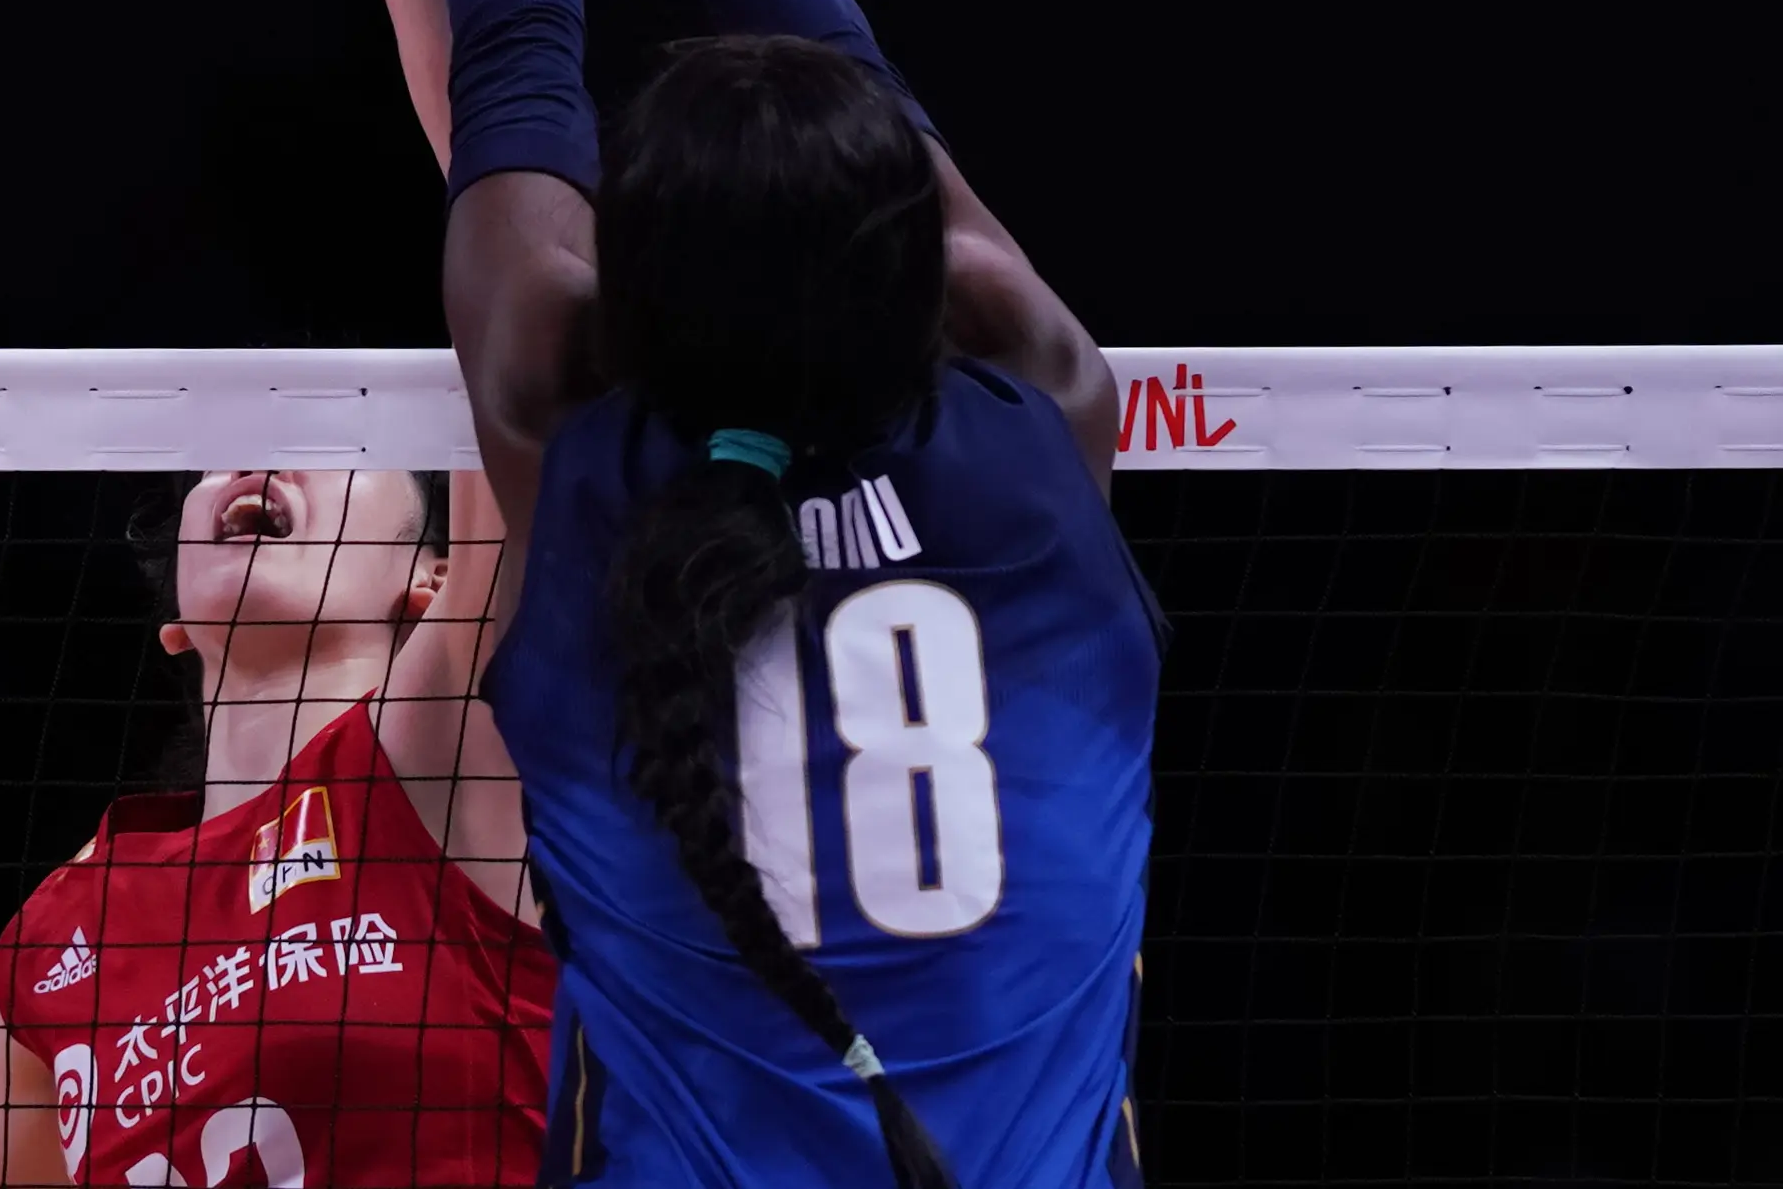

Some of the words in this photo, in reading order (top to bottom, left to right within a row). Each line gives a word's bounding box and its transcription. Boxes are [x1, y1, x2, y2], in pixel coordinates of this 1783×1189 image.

[733, 578, 1005, 950] 18
[33, 953, 97, 994] adidas
[114, 912, 404, 1083] 太平洋保险
[115, 1043, 206, 1129] CPIC
